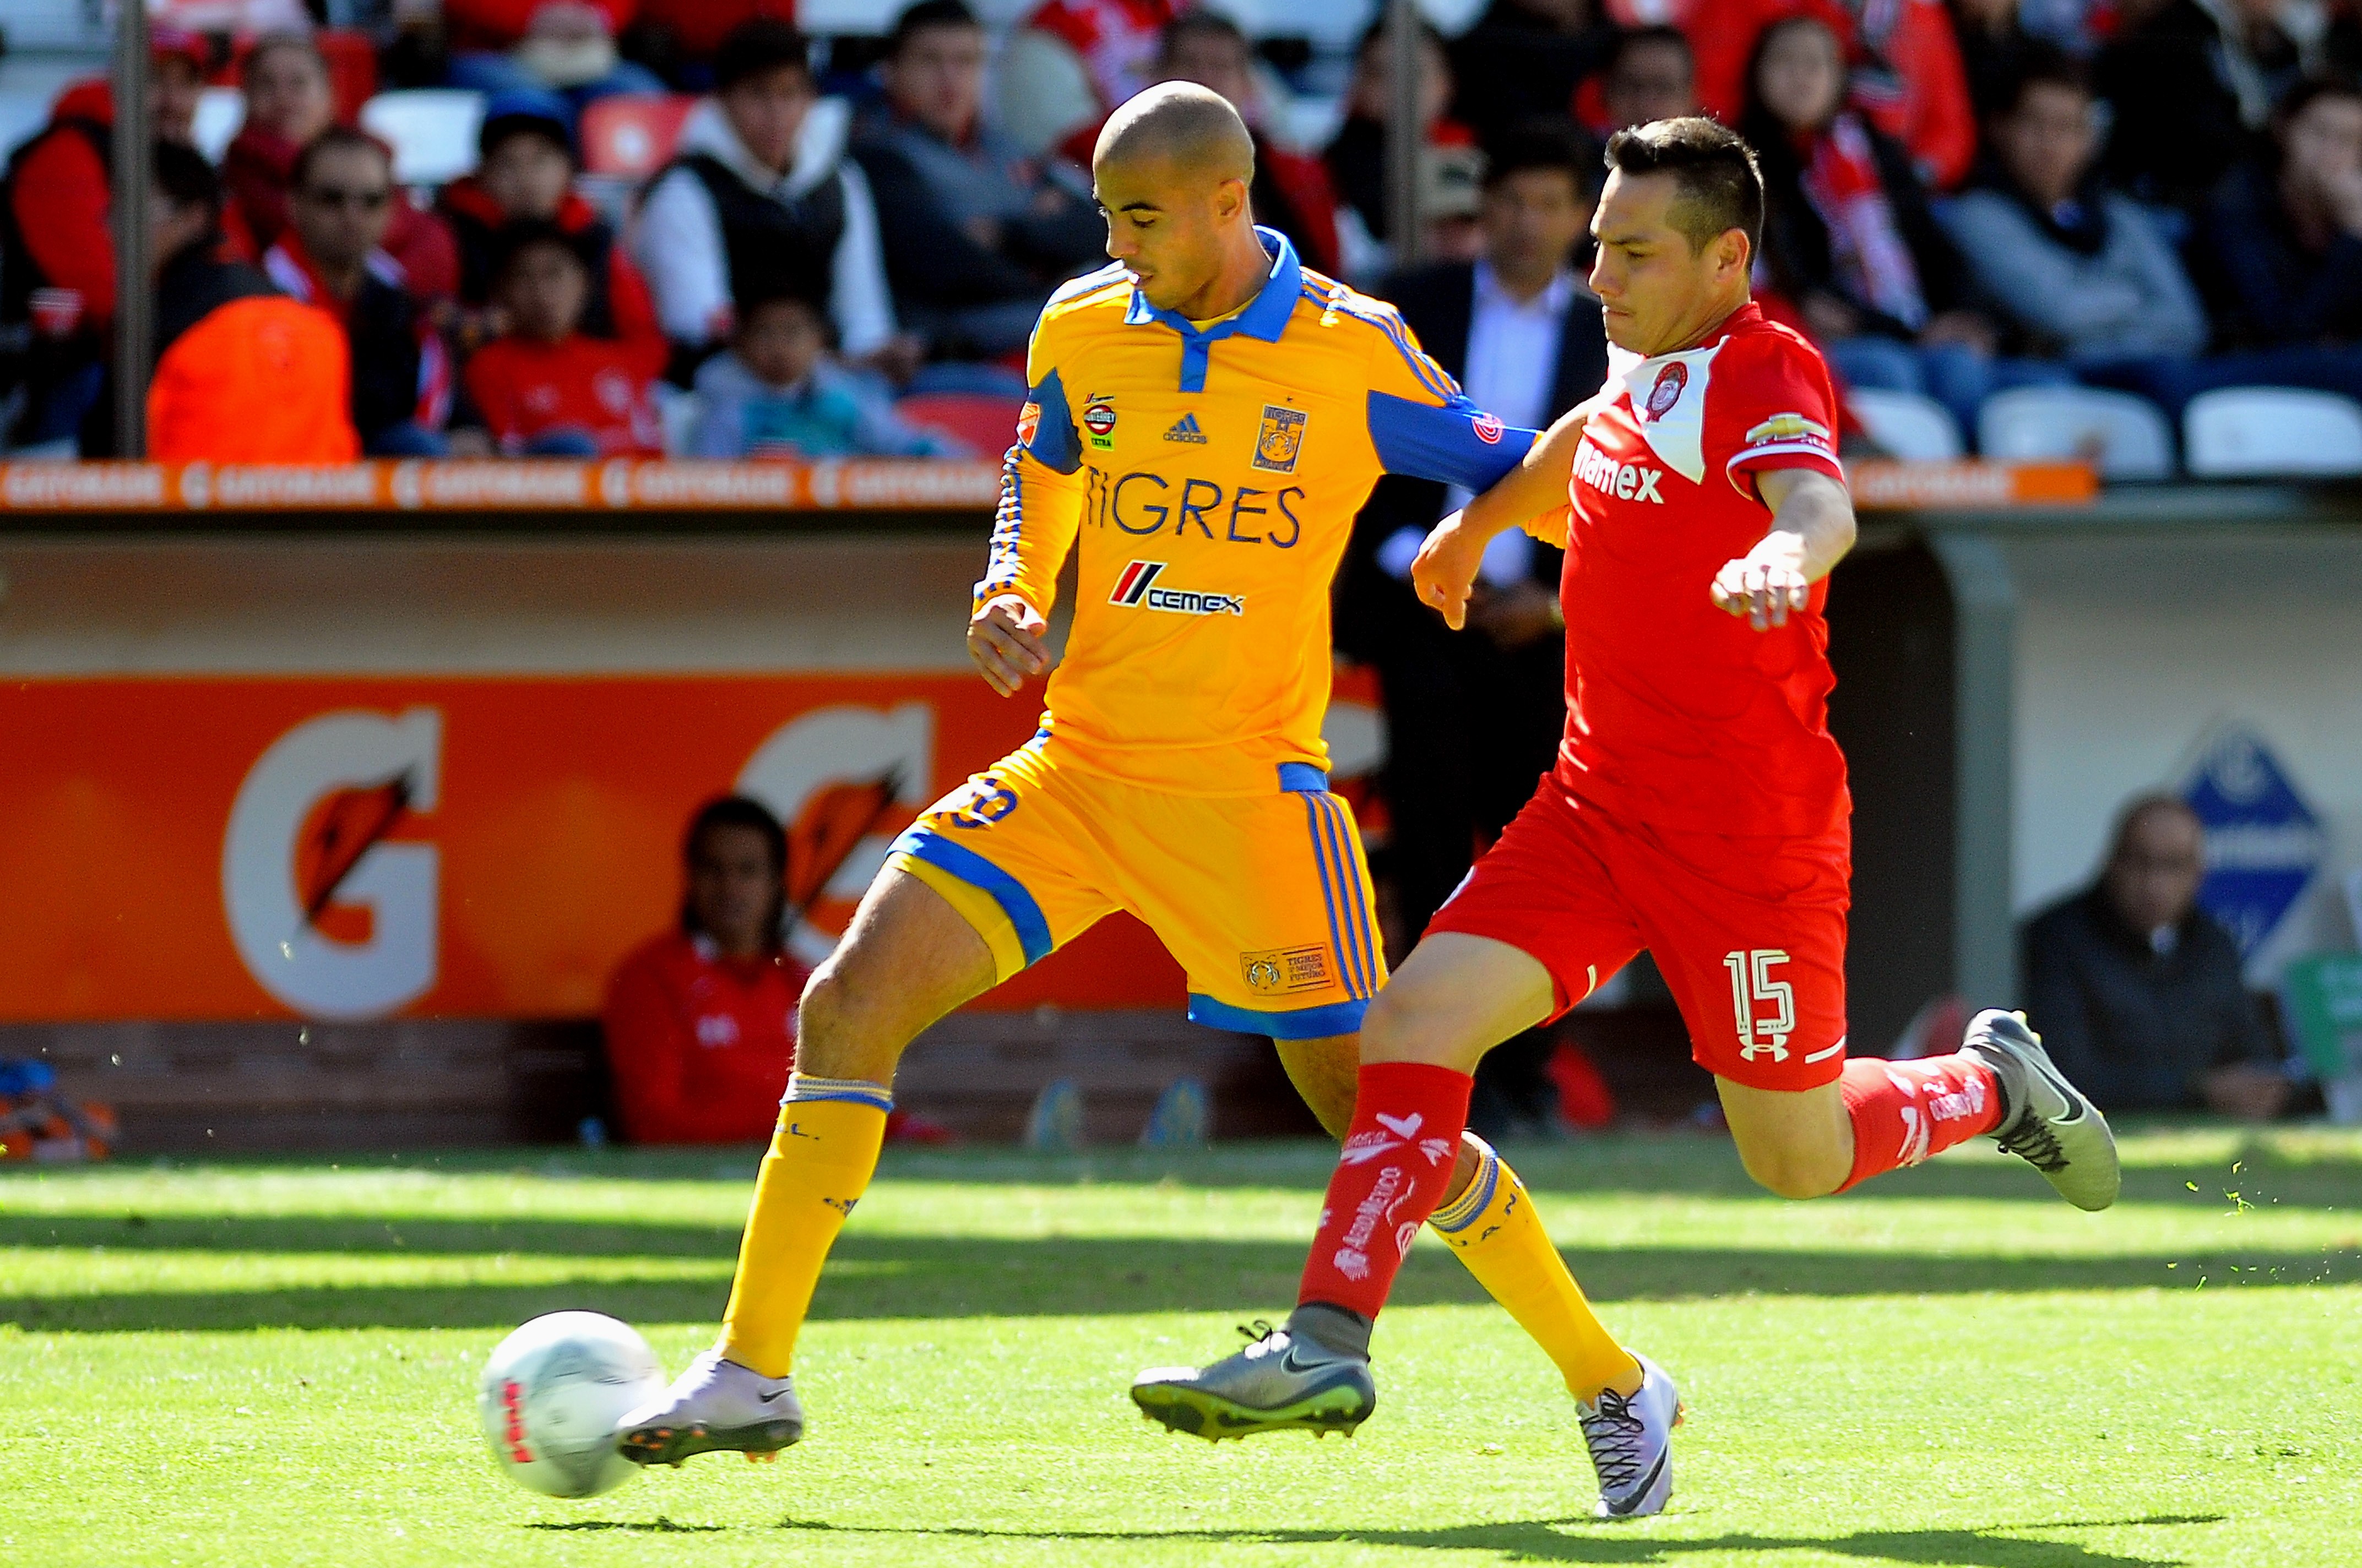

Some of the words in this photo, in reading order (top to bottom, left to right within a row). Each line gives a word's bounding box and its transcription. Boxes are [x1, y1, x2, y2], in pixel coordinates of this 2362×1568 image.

[1163, 432, 1207, 444] adidas
[1088, 465, 1305, 549] TIGRES
[1149, 589, 1244, 613] CEMEX
[221, 706, 439, 1020] G
[1723, 949, 1796, 1036] 15
